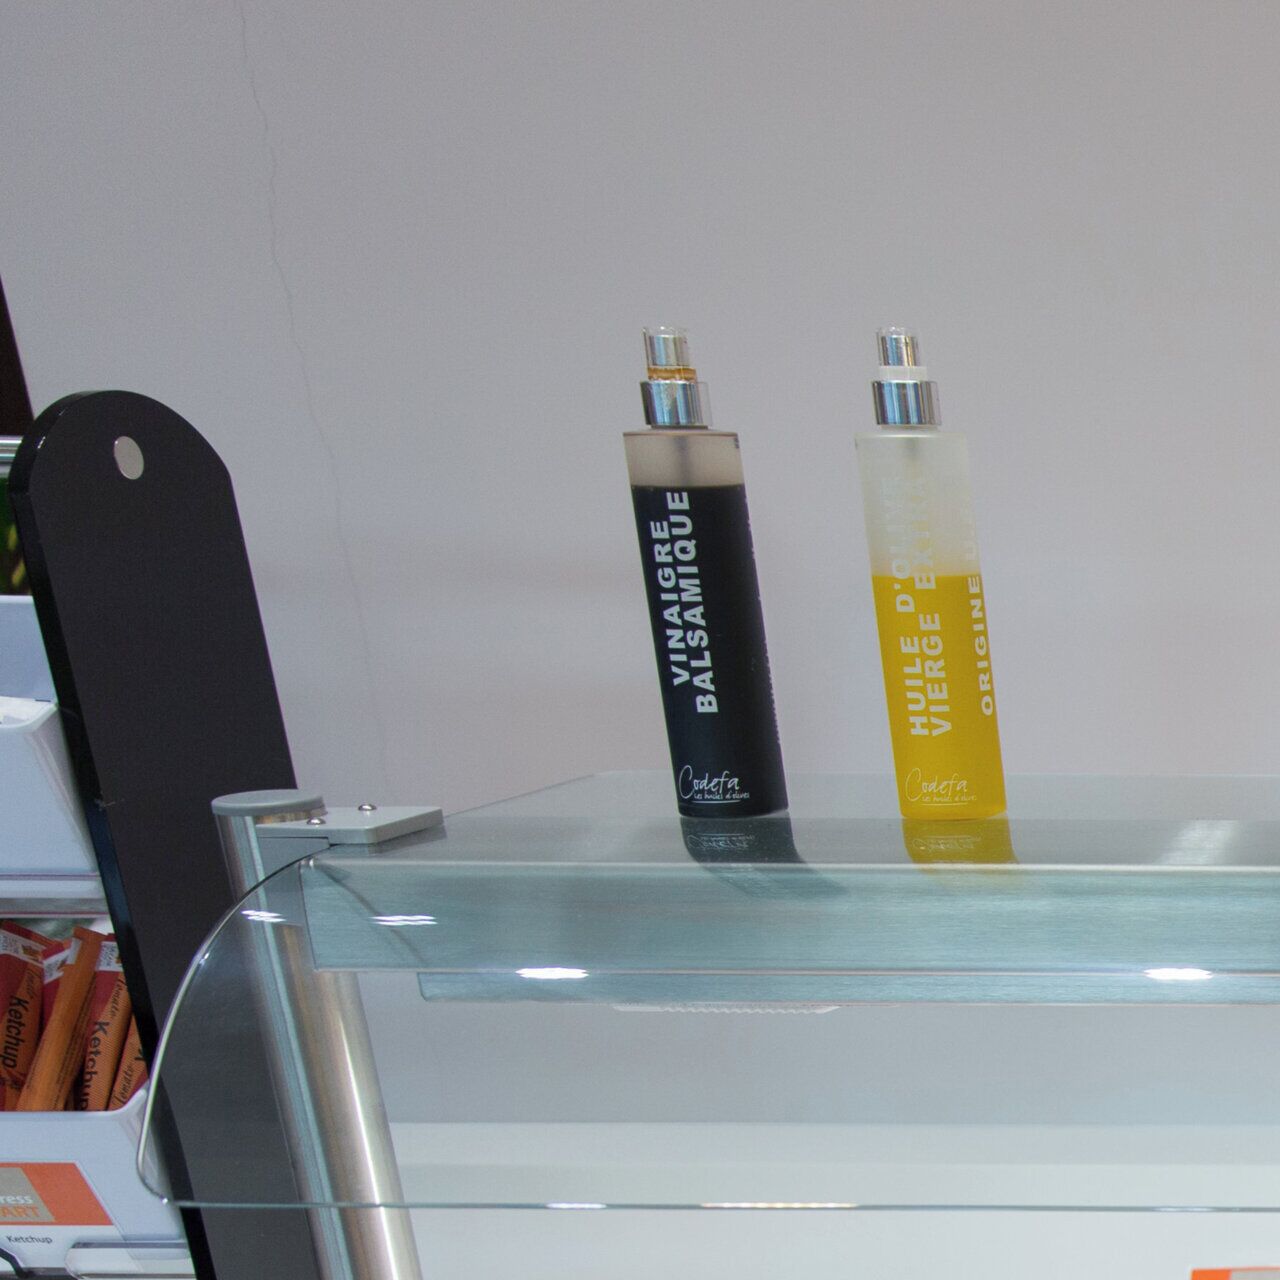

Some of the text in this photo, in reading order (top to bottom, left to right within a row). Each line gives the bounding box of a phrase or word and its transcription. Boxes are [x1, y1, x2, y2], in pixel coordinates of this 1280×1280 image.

[650, 520, 691, 686] VINAIGRE
[666, 491, 719, 713] BALSAMIQUE
[967, 575, 994, 717] ORIGINE
[900, 635, 930, 736] HUILE
[918, 613, 952, 737] VIERGE
[679, 765, 740, 799] Codefa
[2, 996, 30, 1069] Ketchup
[82, 1020, 111, 1111] Ketchup
[0, 1195, 34, 1205] ress
